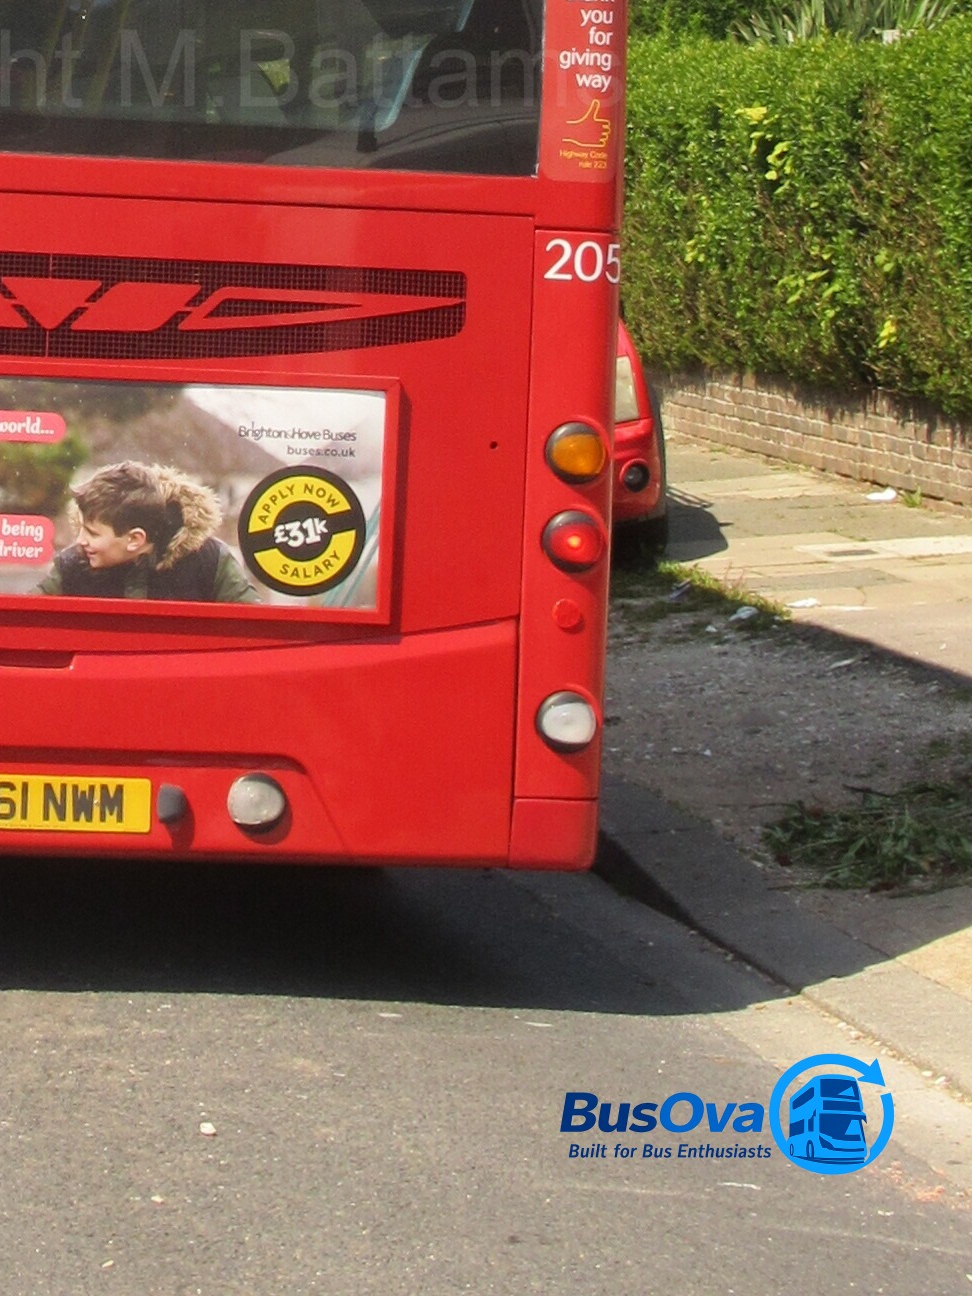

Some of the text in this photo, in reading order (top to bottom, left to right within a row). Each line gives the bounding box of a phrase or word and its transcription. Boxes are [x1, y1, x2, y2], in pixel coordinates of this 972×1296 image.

[580, 9, 614, 27] you
[589, 26, 614, 46] for
[559, 47, 612, 72] giving
[575, 72, 612, 93] way
[559, 149, 608, 160] Highway Code
[322, 429, 357, 442] Buses
[287, 445, 356, 458] buses.co.uk
[258, 483, 340, 525] APPLY NOW
[1, 517, 45, 542] being
[280, 550, 341, 579] SALARY
[42, 783, 125, 824] NWM
